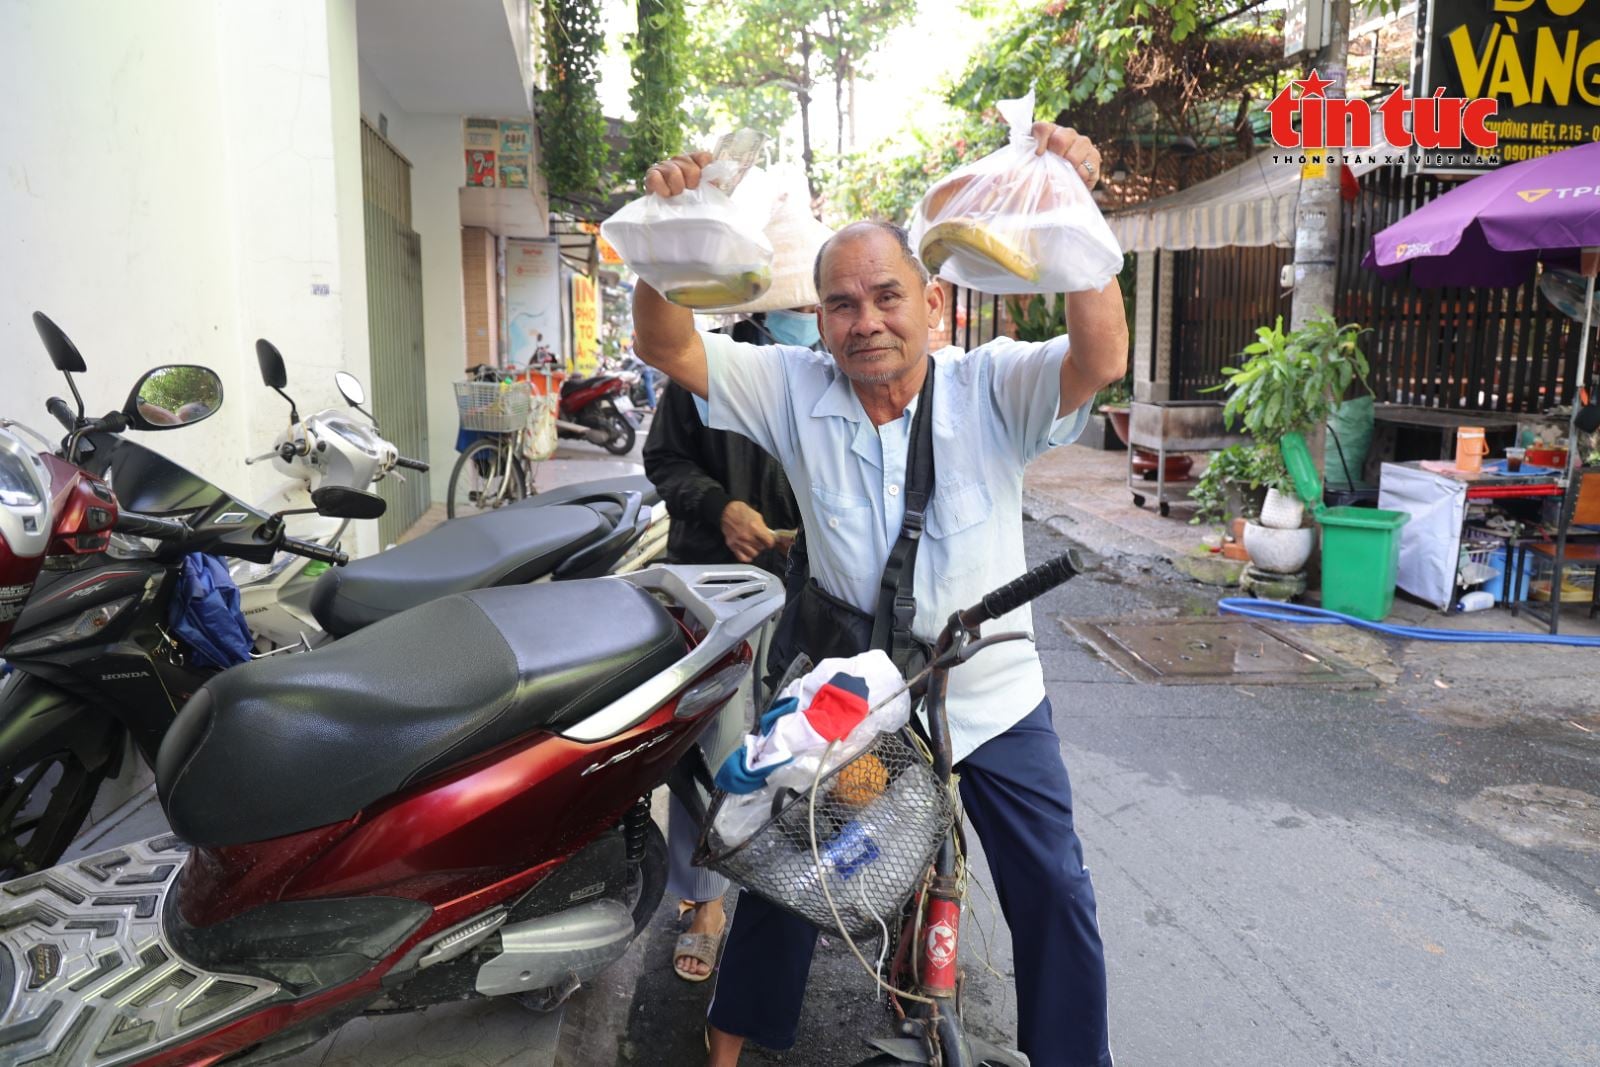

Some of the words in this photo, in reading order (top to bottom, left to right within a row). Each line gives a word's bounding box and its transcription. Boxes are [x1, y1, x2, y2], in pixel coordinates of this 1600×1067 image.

[1447, 15, 1600, 108] VÀNG
[1559, 124, 1582, 141] P.15
[575, 279, 595, 302] IN
[101, 671, 150, 681] HONDA
